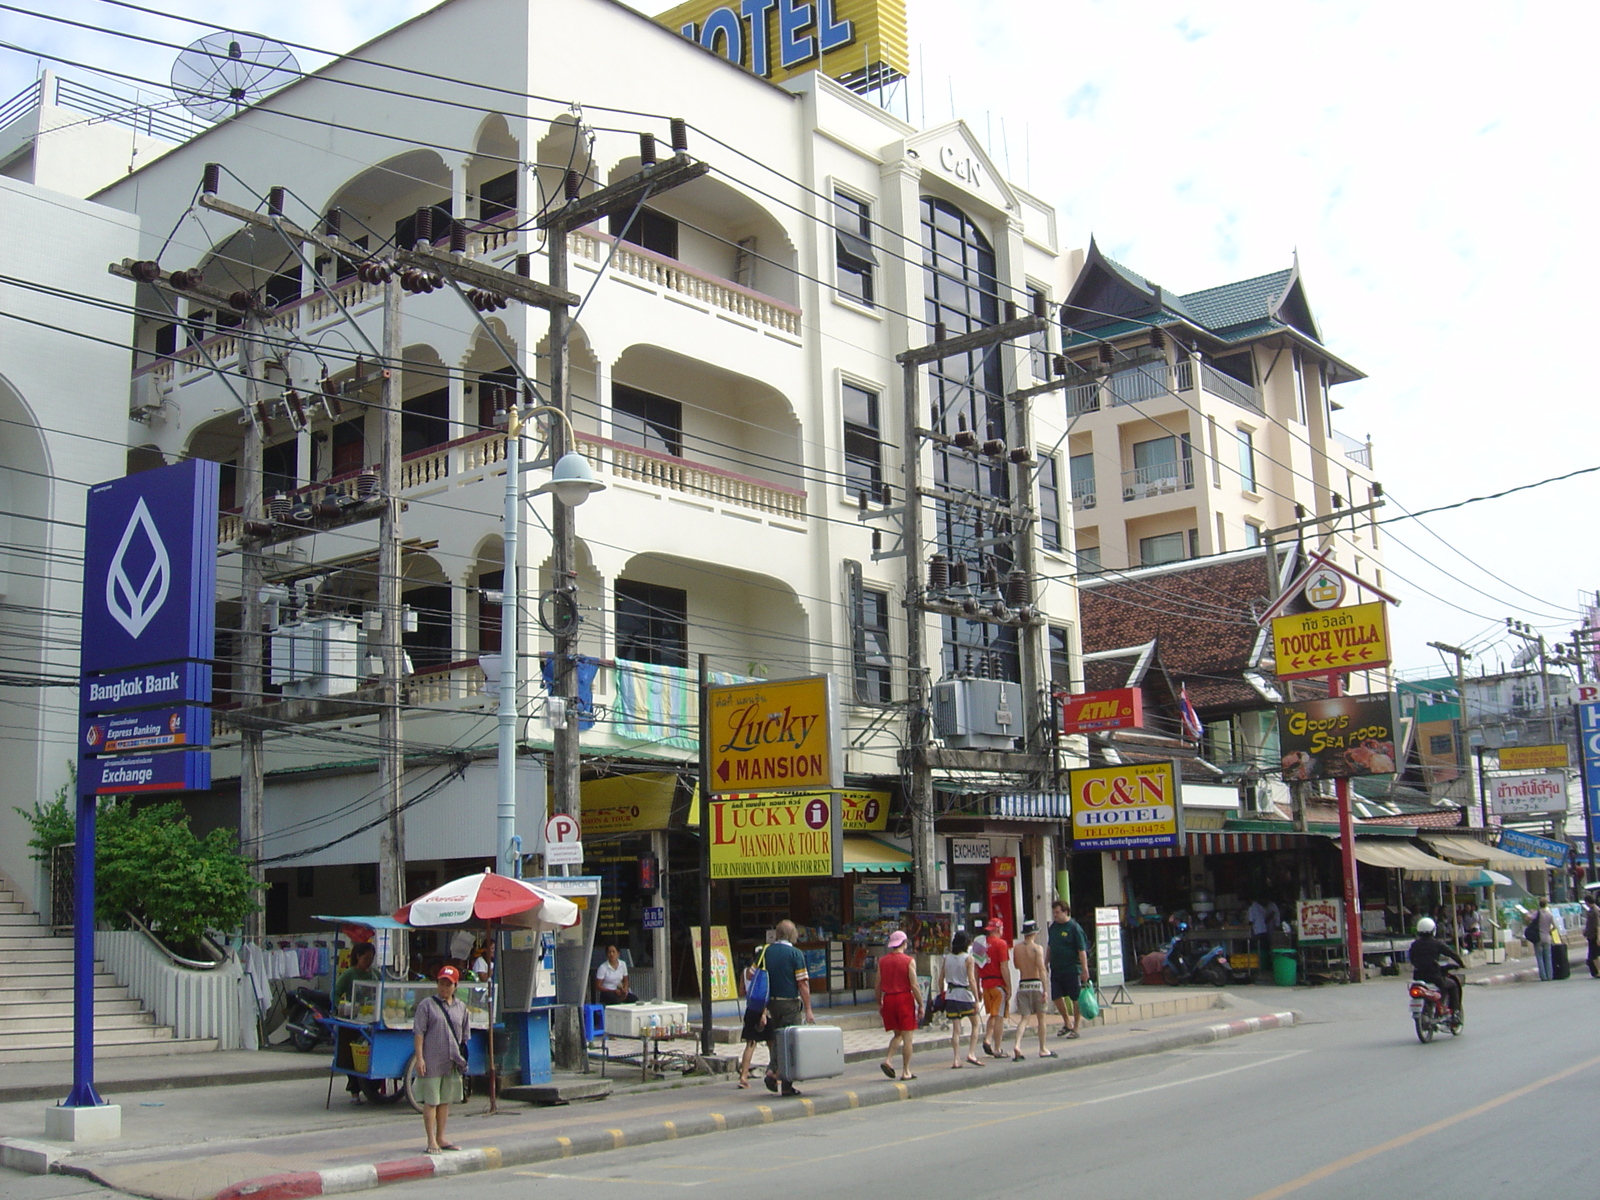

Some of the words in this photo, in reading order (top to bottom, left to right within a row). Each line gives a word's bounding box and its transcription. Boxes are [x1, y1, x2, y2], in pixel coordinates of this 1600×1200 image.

[681, 0, 851, 77] OTEL
[1281, 630, 1332, 656] TOUCH
[1333, 624, 1380, 648] VILLA
[90, 679, 143, 702] Bangkok
[145, 671, 180, 694] Bank
[1077, 700, 1119, 721] ATM
[107, 728, 132, 740] Express
[133, 724, 161, 736] Banking
[719, 703, 819, 753] Lucky
[1349, 726, 1388, 746] FOOD
[101, 768, 153, 785] Exchange
[737, 754, 822, 780] MANSION
[1082, 775, 1165, 807] C&N
[712, 803, 801, 845] LUCKY
[1086, 808, 1166, 824] HOTEL
[556, 822, 571, 843] P
[1079, 836, 1171, 847] www.cnhotelpatong.com
[739, 834, 786, 858] MANSION
[788, 836, 796, 855] &
[798, 831, 830, 855] TOUR
[953, 844, 990, 860] EXCHANGE
[712, 863, 728, 877] TOUR
[729, 862, 770, 876] INFORMATION
[777, 861, 799, 874] ROOMS
[800, 860, 813, 873] FOR
[813, 859, 830, 873] RENT
